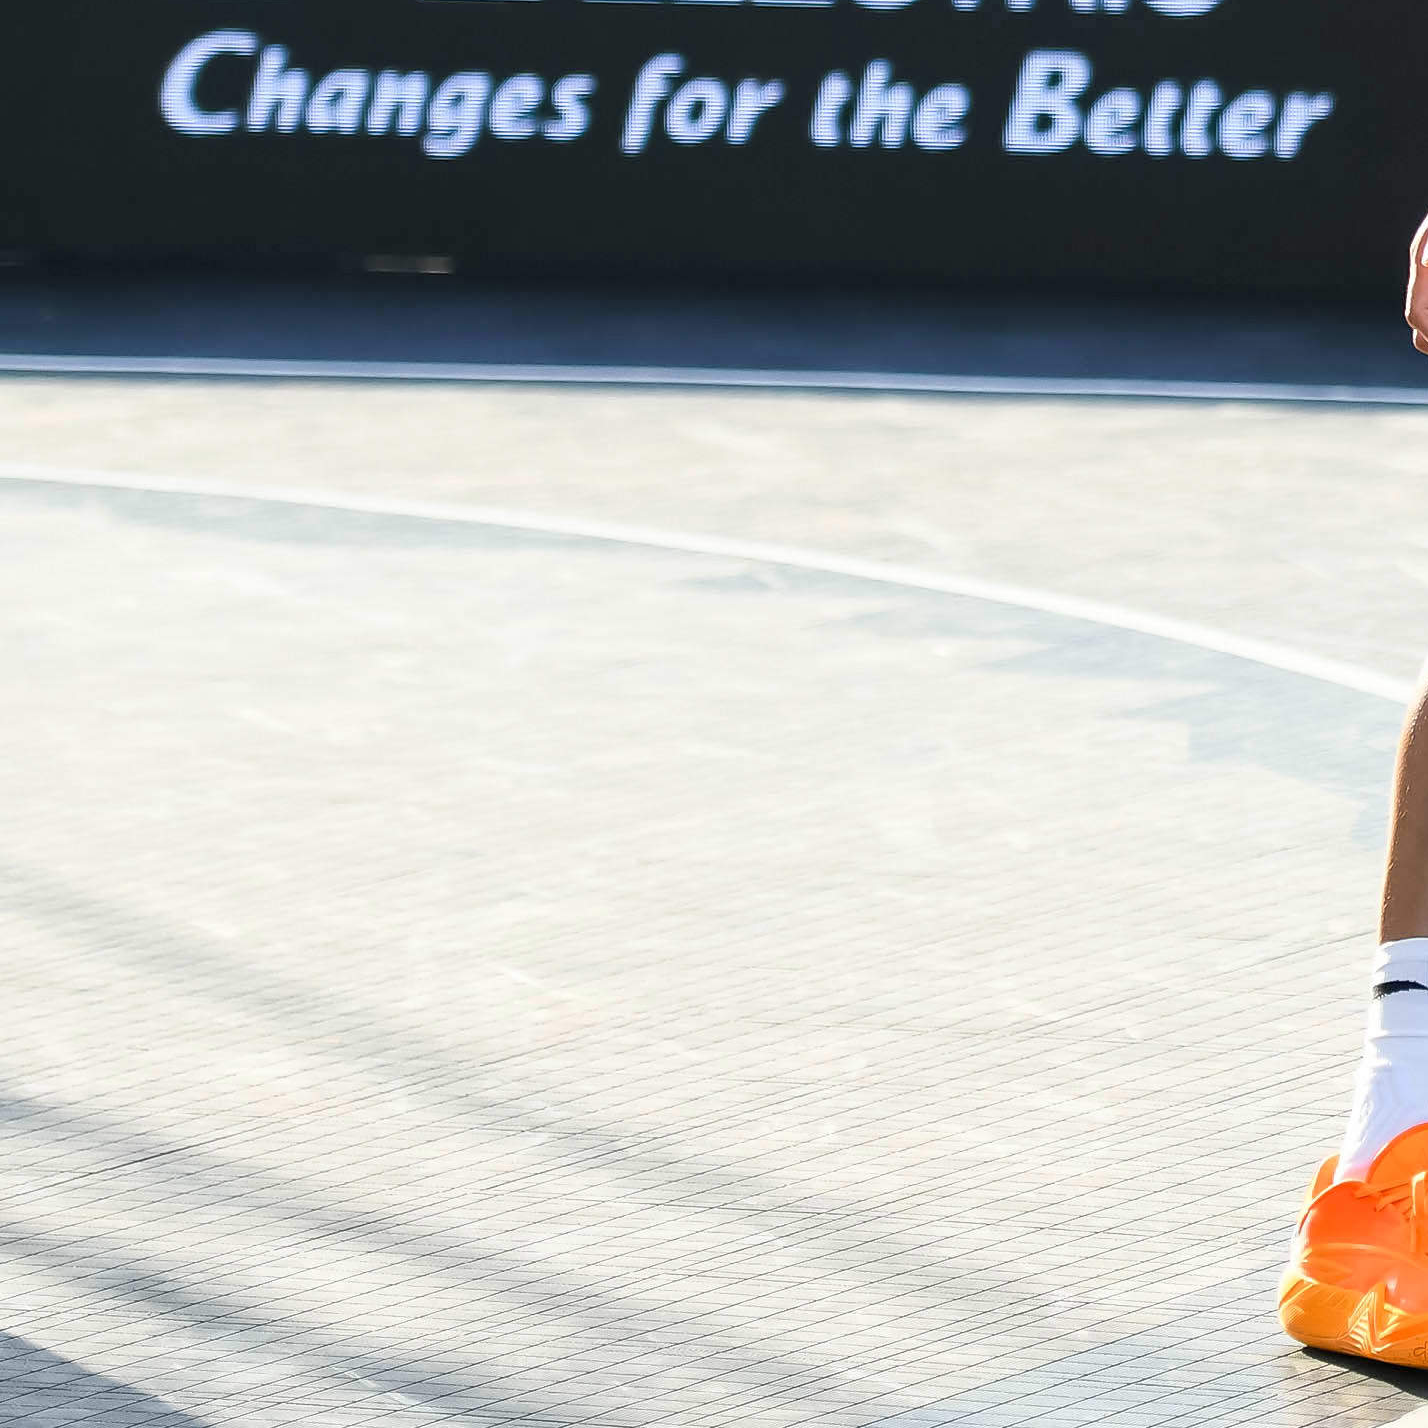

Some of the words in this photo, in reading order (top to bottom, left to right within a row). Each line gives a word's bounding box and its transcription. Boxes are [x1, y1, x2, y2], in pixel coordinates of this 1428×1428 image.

[158, 30, 596, 160] Changes
[621, 53, 787, 156] for
[808, 58, 972, 152] the
[1002, 49, 1335, 159] Better
